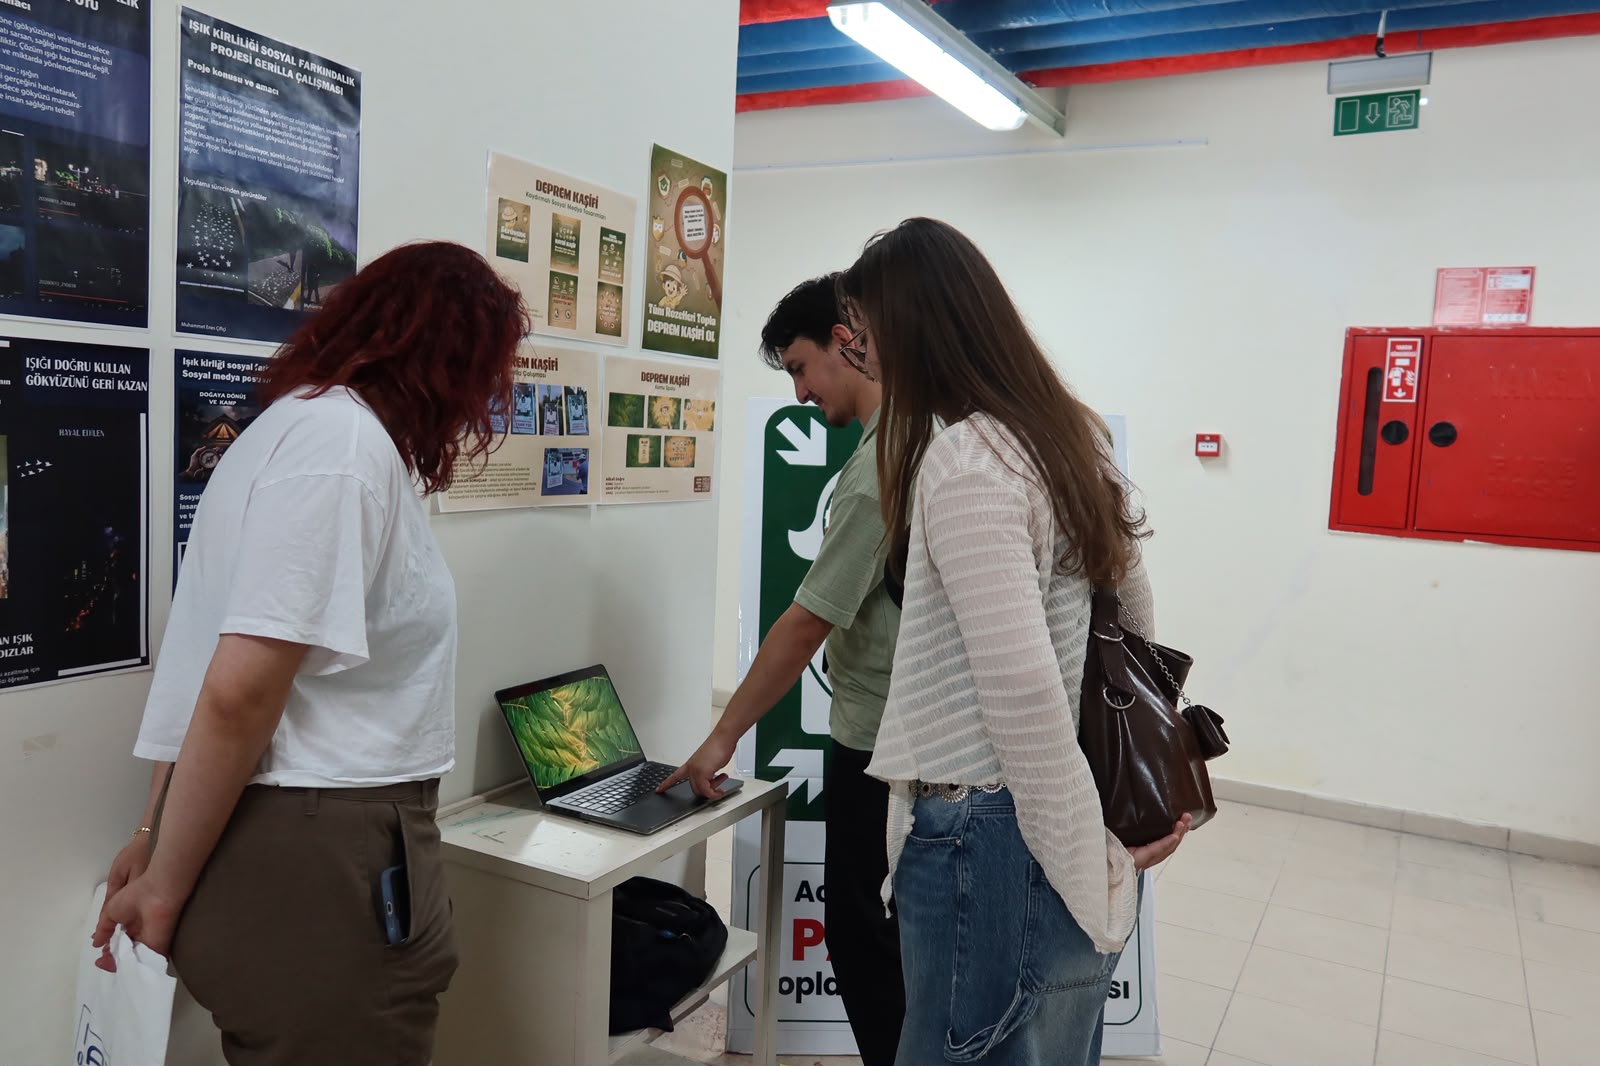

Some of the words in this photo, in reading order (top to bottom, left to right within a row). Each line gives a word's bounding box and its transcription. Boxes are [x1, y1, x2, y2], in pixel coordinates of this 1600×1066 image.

[57, 34, 87, 48] verilmesi
[88, 44, 110, 56] sadece
[189, 19, 211, 35] IŞIK
[212, 28, 259, 53] KİRLİLİĞİ
[260, 45, 297, 66] SOSYAL
[298, 59, 356, 87] FARKINDALIK
[12, 50, 43, 64] miktarda
[19, 41, 43, 55] Çözüm
[59, 54, 91, 69] kapatmak
[71, 48, 92, 59] bozan
[101, 56, 113, 66] bizi
[187, 59, 211, 74] Proje
[212, 67, 243, 84] konusu
[244, 79, 254, 87] ve
[255, 82, 279, 96] amacı
[210, 42, 252, 65] PROJESİ
[254, 57, 294, 79] GERİLLA
[295, 73, 344, 96] ÇALIŞMASI
[183, 176, 211, 189] Uygulama
[535, 179, 572, 201] DEPREM
[572, 193, 599, 209] KAŞİFİ
[648, 303, 665, 317] Tüm
[696, 313, 717, 326] Topla
[647, 319, 680, 337] DEPREM
[680, 325, 705, 342] KAŞİFİ
[705, 330, 716, 342] OL
[25, 356, 51, 371] IŞIĞI
[54, 358, 91, 372] DOĞRU
[94, 362, 131, 375] KULLAN
[182, 357, 199, 367] Işık
[227, 362, 253, 372] sosyal
[531, 357, 558, 373] KAŞİFİ
[25, 373, 89, 389] GÖKYÜZÜNÜ
[92, 377, 115, 390] GERİ
[117, 380, 148, 392] KAZAN
[182, 370, 211, 380] Sosyal
[212, 372, 241, 383] medya
[641, 371, 669, 384] DEPREM
[669, 374, 690, 388] KAŞİFİ
[58, 429, 81, 437] HAYAL
[13, 633, 33, 645] IŞIK
